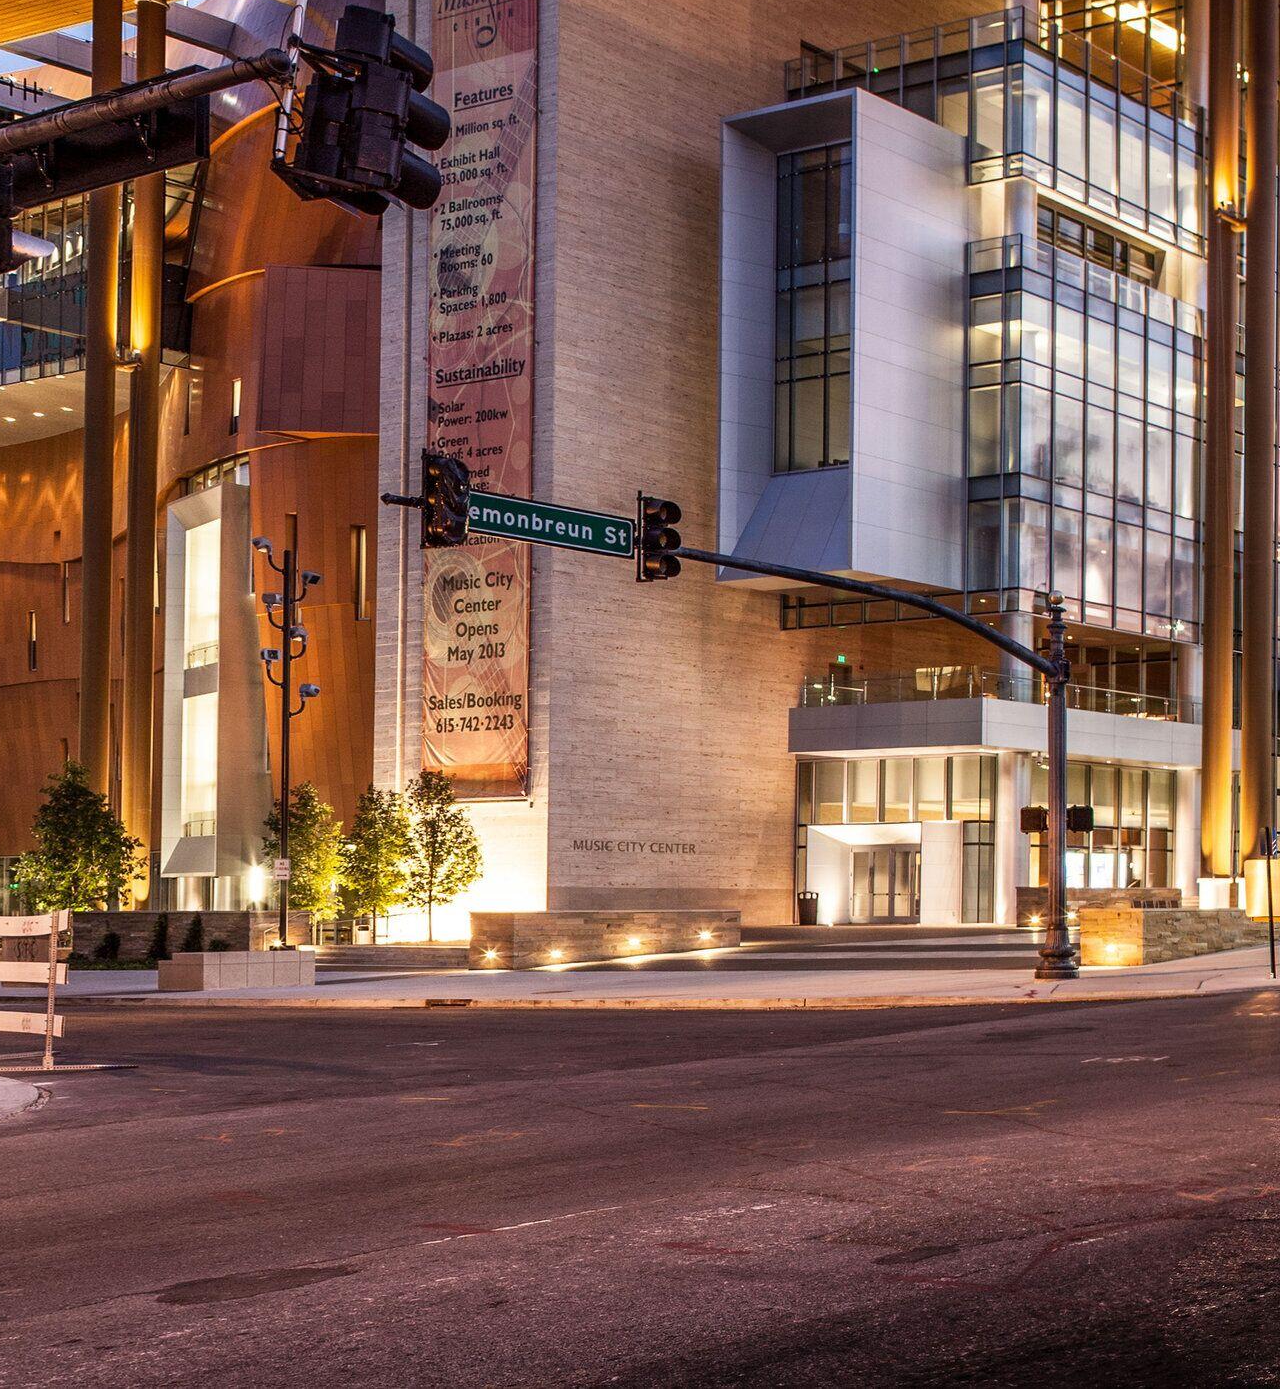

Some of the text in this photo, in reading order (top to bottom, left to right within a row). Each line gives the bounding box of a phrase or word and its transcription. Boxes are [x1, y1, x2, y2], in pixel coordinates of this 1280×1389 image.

[454, 82, 513, 108] Features
[456, 121, 489, 137] Million
[492, 119, 506, 131] sq.
[509, 113, 520, 126] ft.
[441, 146, 500, 169] Exhibit Hall
[440, 162, 508, 187] 353,000 sq. ft.
[440, 194, 504, 215] 2 Ballrooms:
[440, 209, 503, 232] 75,000 sq. ft.
[440, 243, 481, 260] Meeting
[440, 253, 493, 274] Rooms: 60
[440, 283, 478, 299] Parking
[439, 291, 507, 315] Spaces: 1,800
[439, 322, 513, 344] Plazas: 2 acres
[435, 358, 526, 386] Sustainability
[438, 401, 465, 414] Solar
[438, 409, 508, 428] Power: 200kw
[437, 436, 469, 449] Green
[467, 446, 473, 458] 4
[476, 445, 503, 458] acres
[469, 505, 627, 547] emonbreun St
[442, 571, 513, 592] Music City
[453, 597, 502, 614] Center
[455, 622, 499, 641] Opens
[447, 643, 505, 664] May 2013
[428, 692, 522, 713] Sales/Booking
[573, 840, 696, 854] MUSIC CITY CENTER
